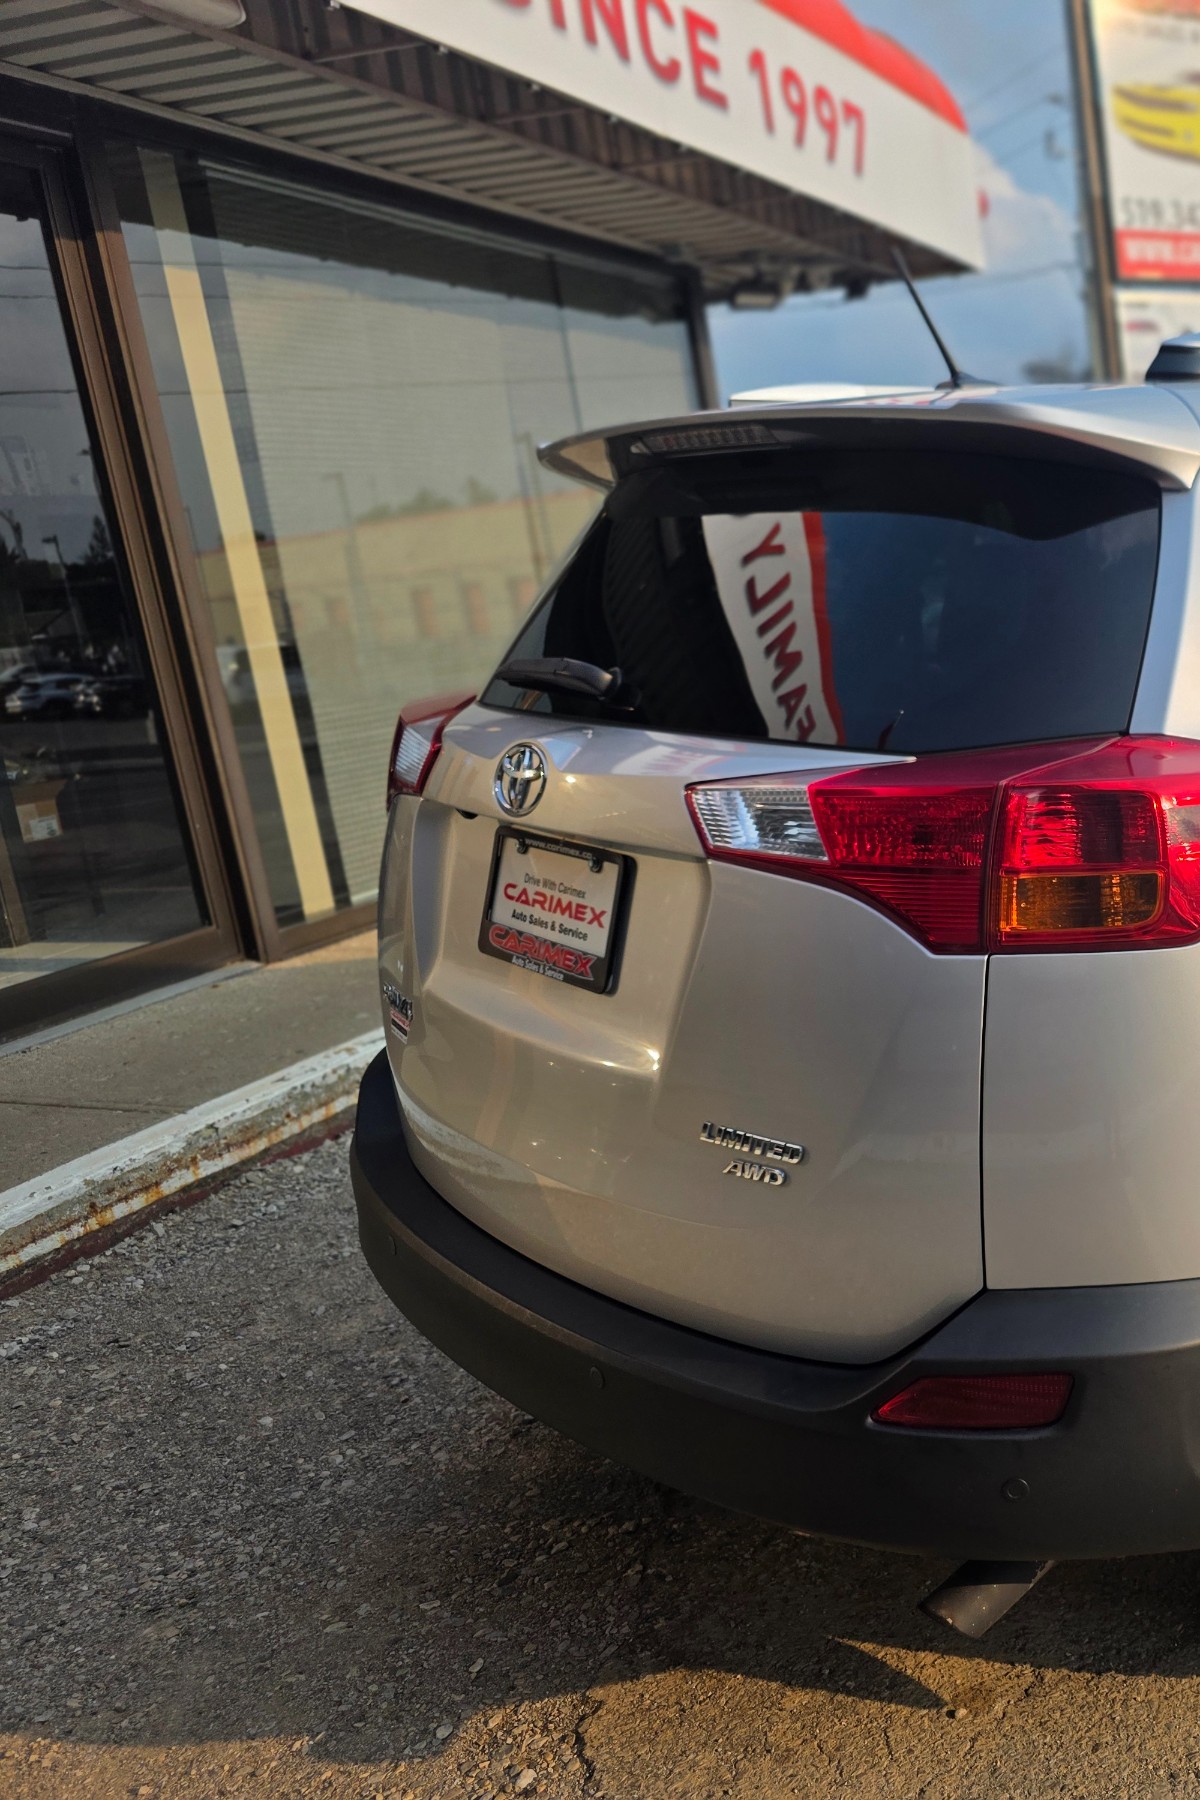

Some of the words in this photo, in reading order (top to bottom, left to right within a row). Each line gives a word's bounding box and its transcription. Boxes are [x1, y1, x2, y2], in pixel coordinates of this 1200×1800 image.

[507, 0, 728, 110] NCE
[749, 48, 865, 176] 1997
[524, 873, 541, 887] Drive
[541, 878, 557, 892] With
[558, 882, 586, 899] Carimex
[504, 882, 607, 928] CARIMEX
[511, 909, 528, 923] Auto
[529, 914, 549, 930] Sales
[550, 920, 556, 931] &
[558, 924, 588, 941] Service
[489, 925, 596, 979] CARIMEX
[511, 956, 525, 967] Auto
[525, 959, 539, 973] Sales
[544, 966, 564, 981] Service
[700, 1121, 804, 1164] LIMITED
[722, 1160, 785, 1186] AWD
